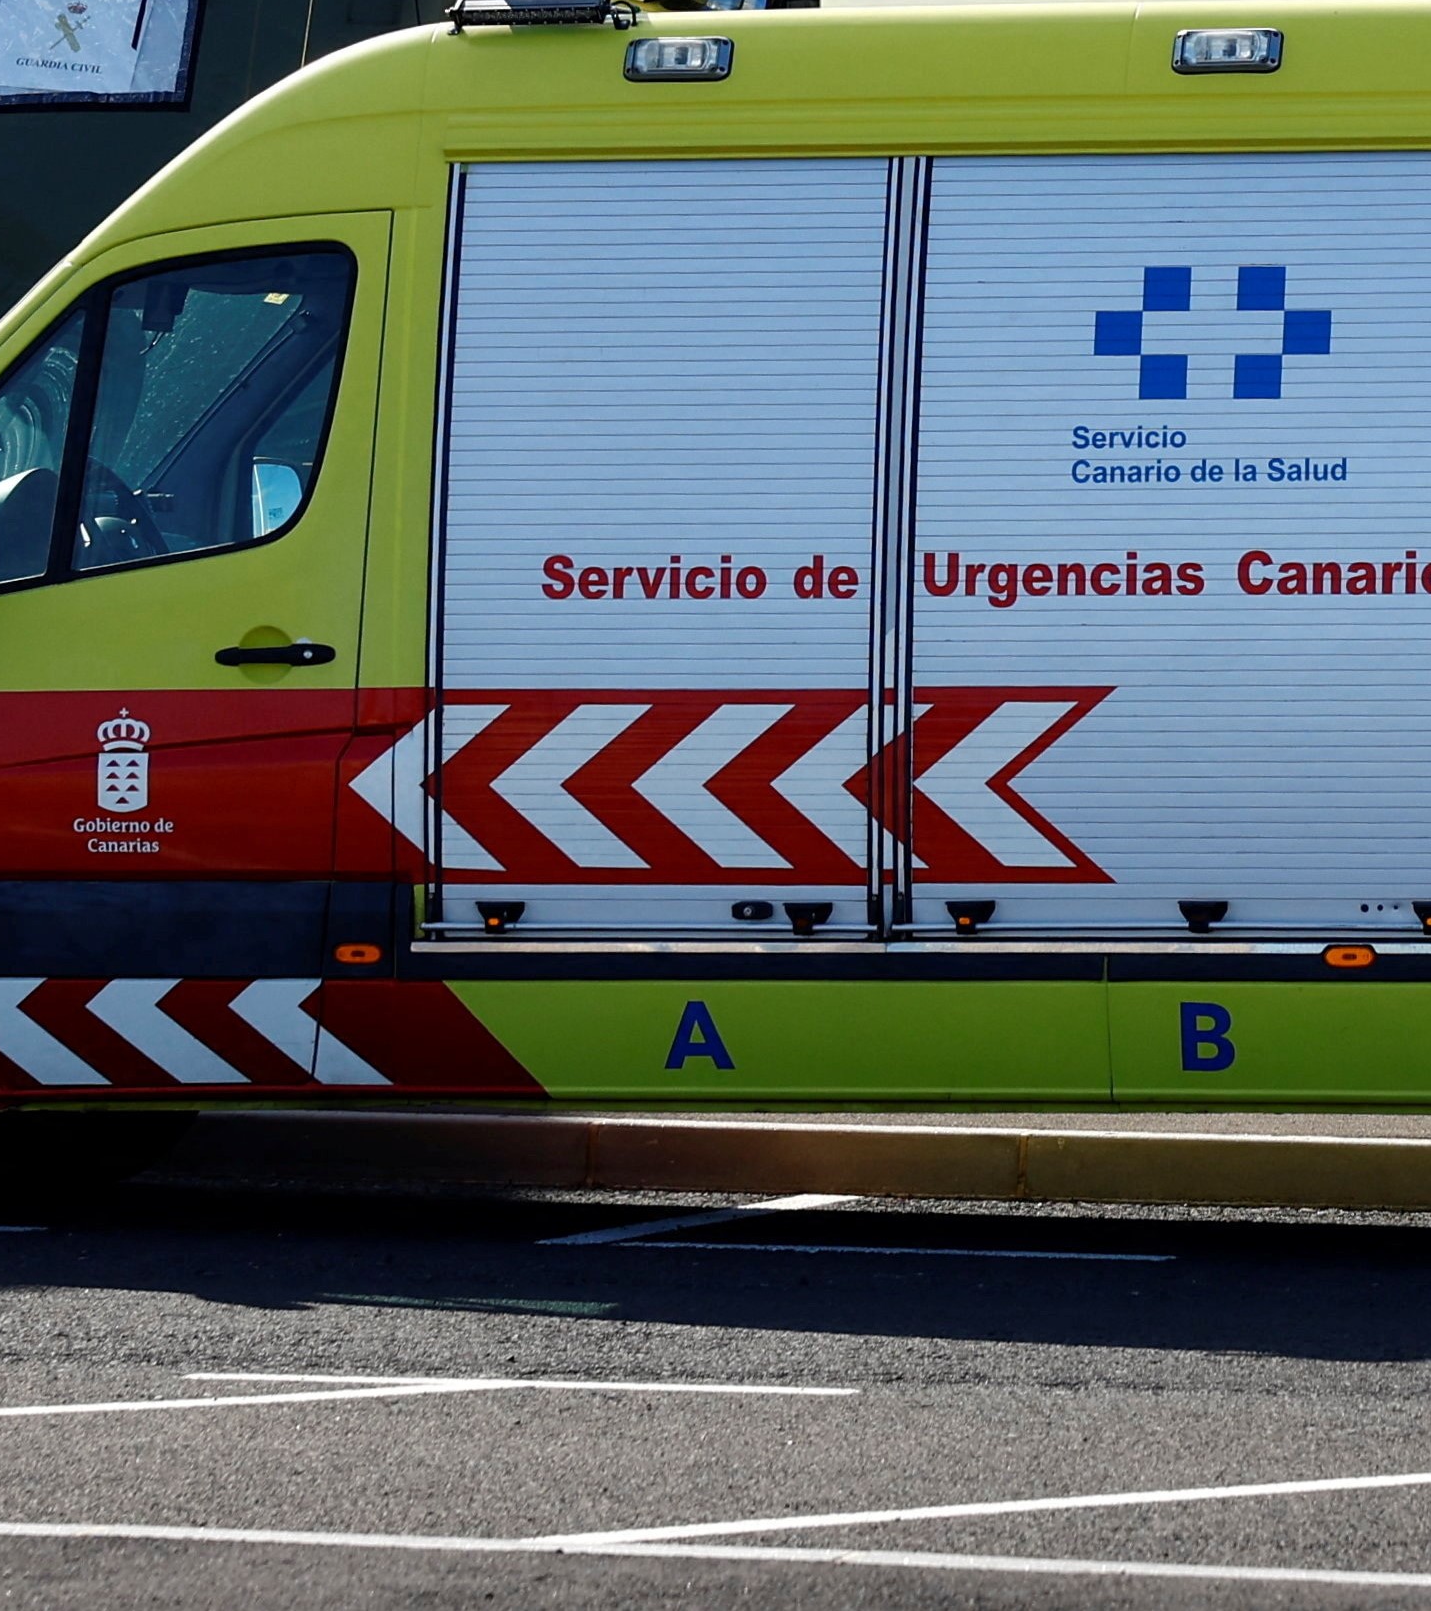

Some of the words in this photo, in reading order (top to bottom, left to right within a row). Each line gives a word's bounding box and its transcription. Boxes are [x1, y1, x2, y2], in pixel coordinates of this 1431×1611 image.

[16, 57, 68, 70] GUARDIA
[70, 62, 102, 74] CIVIL
[1074, 426, 1186, 448] Servicio
[1072, 460, 1180, 483] Canario
[1191, 459, 1223, 482] de
[1235, 460, 1257, 481] la
[1268, 458, 1347, 481] Salud
[544, 556, 766, 599] Servicio
[795, 556, 858, 598] de
[925, 553, 1204, 607] Urgencias
[73, 817, 150, 832] Gobierno
[154, 818, 174, 833] de
[88, 838, 159, 853] Canarias
[666, 1001, 734, 1069] A
[1181, 1002, 1235, 1071] B
